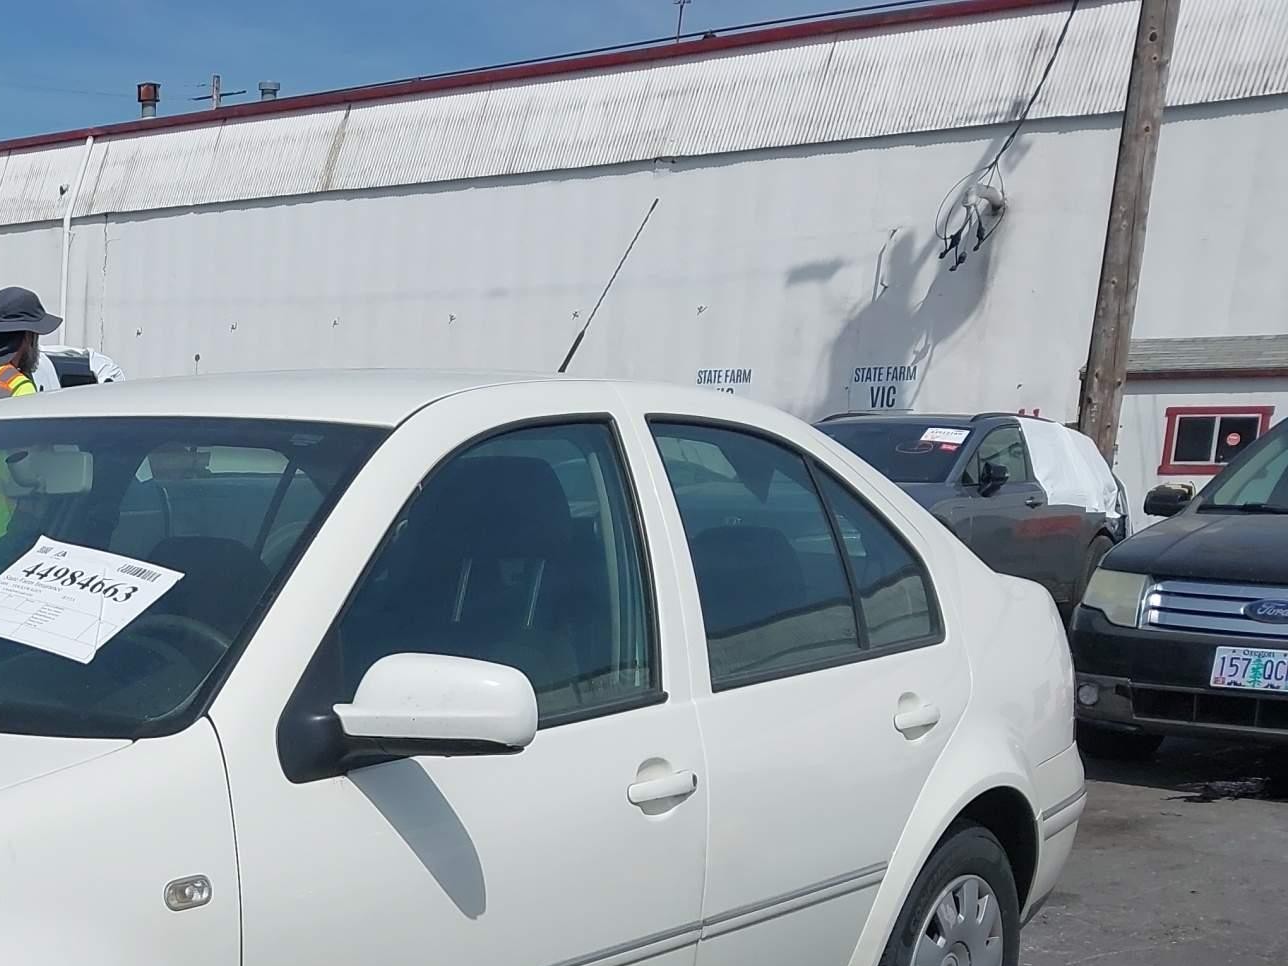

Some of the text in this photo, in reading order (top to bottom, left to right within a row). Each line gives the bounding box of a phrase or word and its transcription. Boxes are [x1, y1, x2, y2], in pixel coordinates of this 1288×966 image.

[697, 368, 752, 385] STATE FARM
[854, 365, 917, 383] STATE FARM
[870, 385, 897, 408] VIC
[22, 561, 139, 602] 44984663
[1219, 656, 1288, 681] 157 QC
